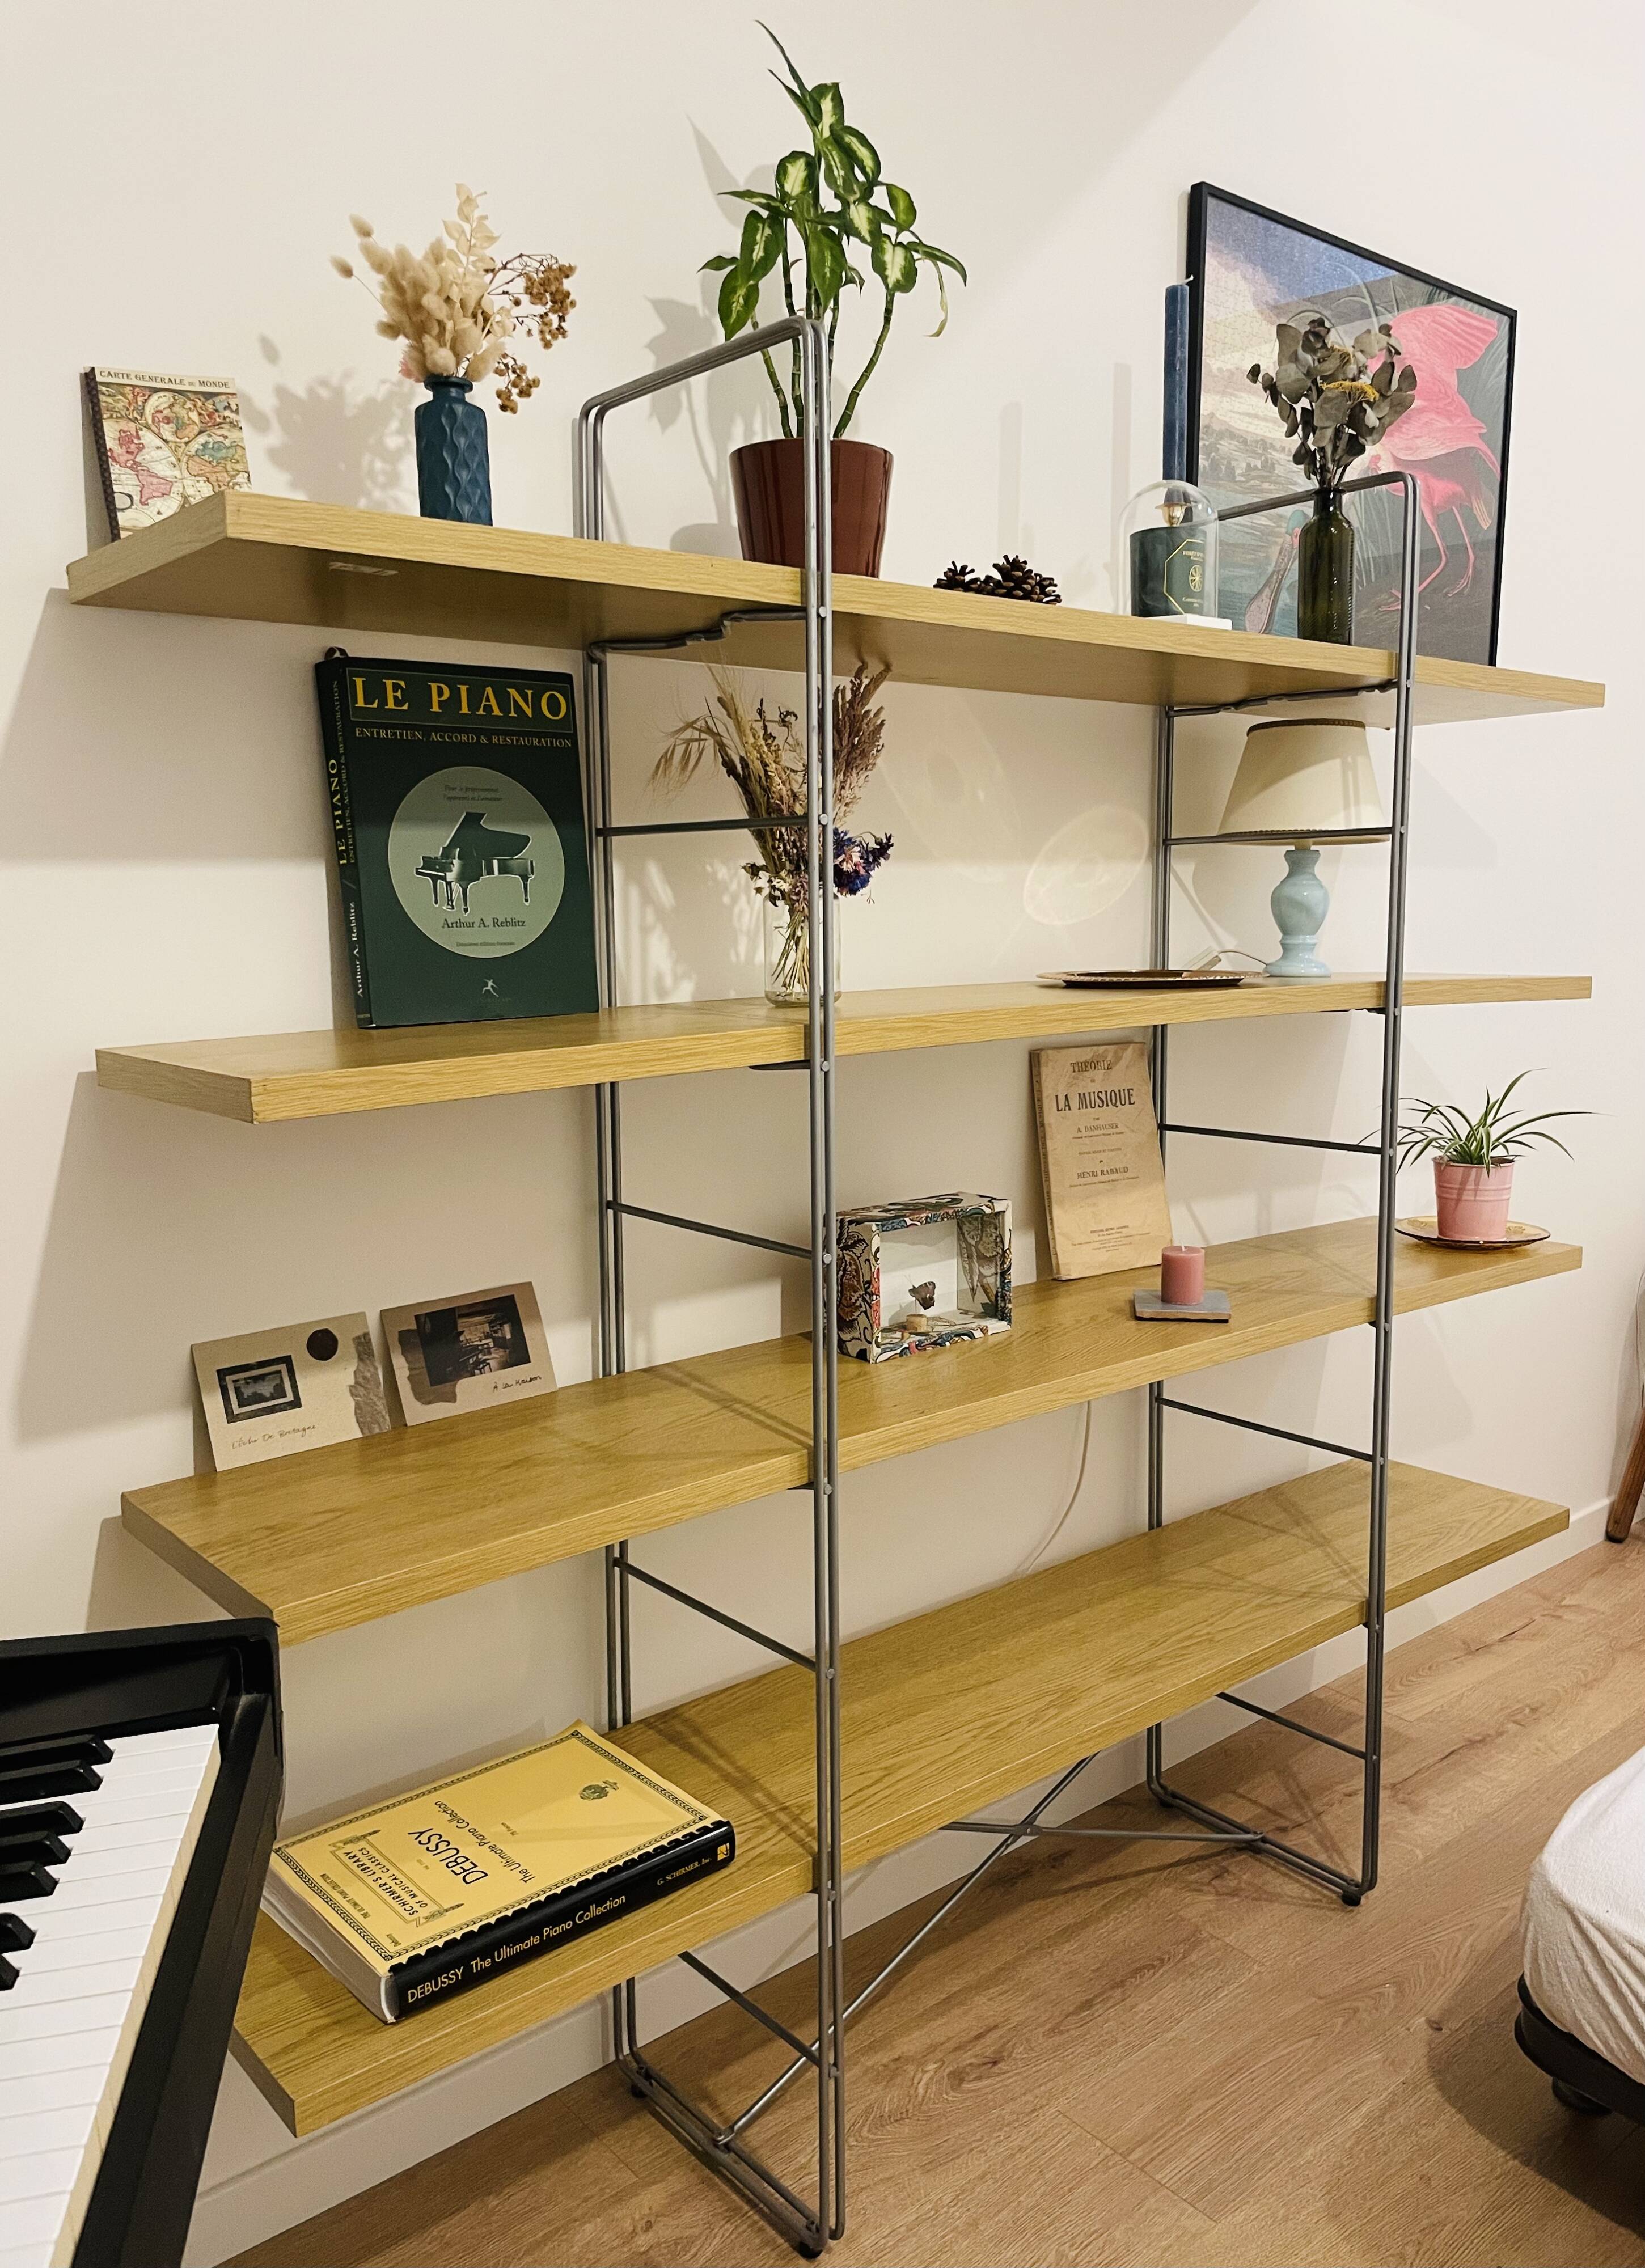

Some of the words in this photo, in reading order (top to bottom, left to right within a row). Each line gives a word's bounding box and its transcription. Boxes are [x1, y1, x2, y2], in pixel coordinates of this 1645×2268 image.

[99, 370, 132, 380] CARTE
[198, 380, 230, 388] MONDE
[352, 676, 409, 710] LE
[428, 682, 568, 720] PIANO
[355, 727, 426, 742] ENTRETIEN,
[430, 732, 476, 743] ACCORD
[480, 734, 489, 743] &
[492, 735, 572, 748] RESTAURATION
[328, 759, 344, 831] PIANO
[341, 765, 350, 805] ACCORD
[337, 839, 348, 864] LE
[349, 902, 358, 941] Reblitz
[442, 918, 476, 929] Arthur
[478, 917, 490, 928] A.
[492, 917, 526, 928] Reblitz
[1055, 1093, 1072, 1112] LA
[1077, 1088, 1135, 1110] MUSIQUE
[1084, 1123, 1119, 1133] DANHAUSER
[1077, 1170, 1098, 1179] HENRI
[1100, 1166, 1129, 1176] RABAUD
[277, 1424, 316, 1438] Bretagne
[434, 1800, 470, 1829] Collection
[468, 1827, 490, 1847] Piano
[342, 1851, 377, 1877] LIBRARY
[358, 1847, 390, 1873] CLASSICS
[408, 1827, 489, 1885] DEBUSSY
[488, 1844, 521, 1872] Ultimate
[387, 1873, 418, 1899] MUSICAL
[519, 1868, 536, 1884] The
[408, 1966, 464, 2003] DEBUSSY
[471, 1957, 492, 1973] The
[494, 1937, 540, 1962] Ultimate
[543, 1920, 573, 1941] Piano
[575, 1895, 625, 1924] Collection
